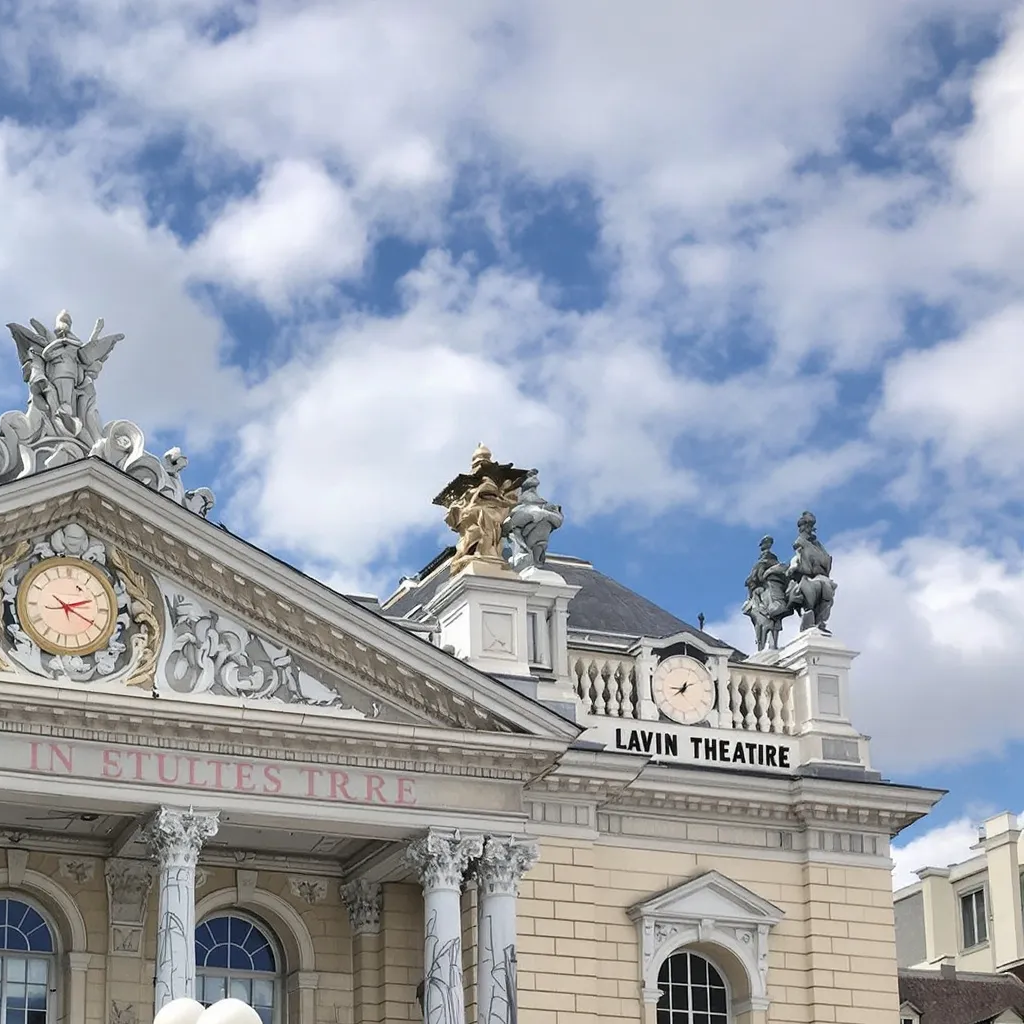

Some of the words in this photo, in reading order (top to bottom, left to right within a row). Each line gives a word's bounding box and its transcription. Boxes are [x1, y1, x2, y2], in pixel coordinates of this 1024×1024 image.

[28, 741, 74, 773] IN
[300, 767, 418, 805] TRRE
[615, 728, 678, 756] LAVIN
[690, 737, 791, 768] THEATIRE
